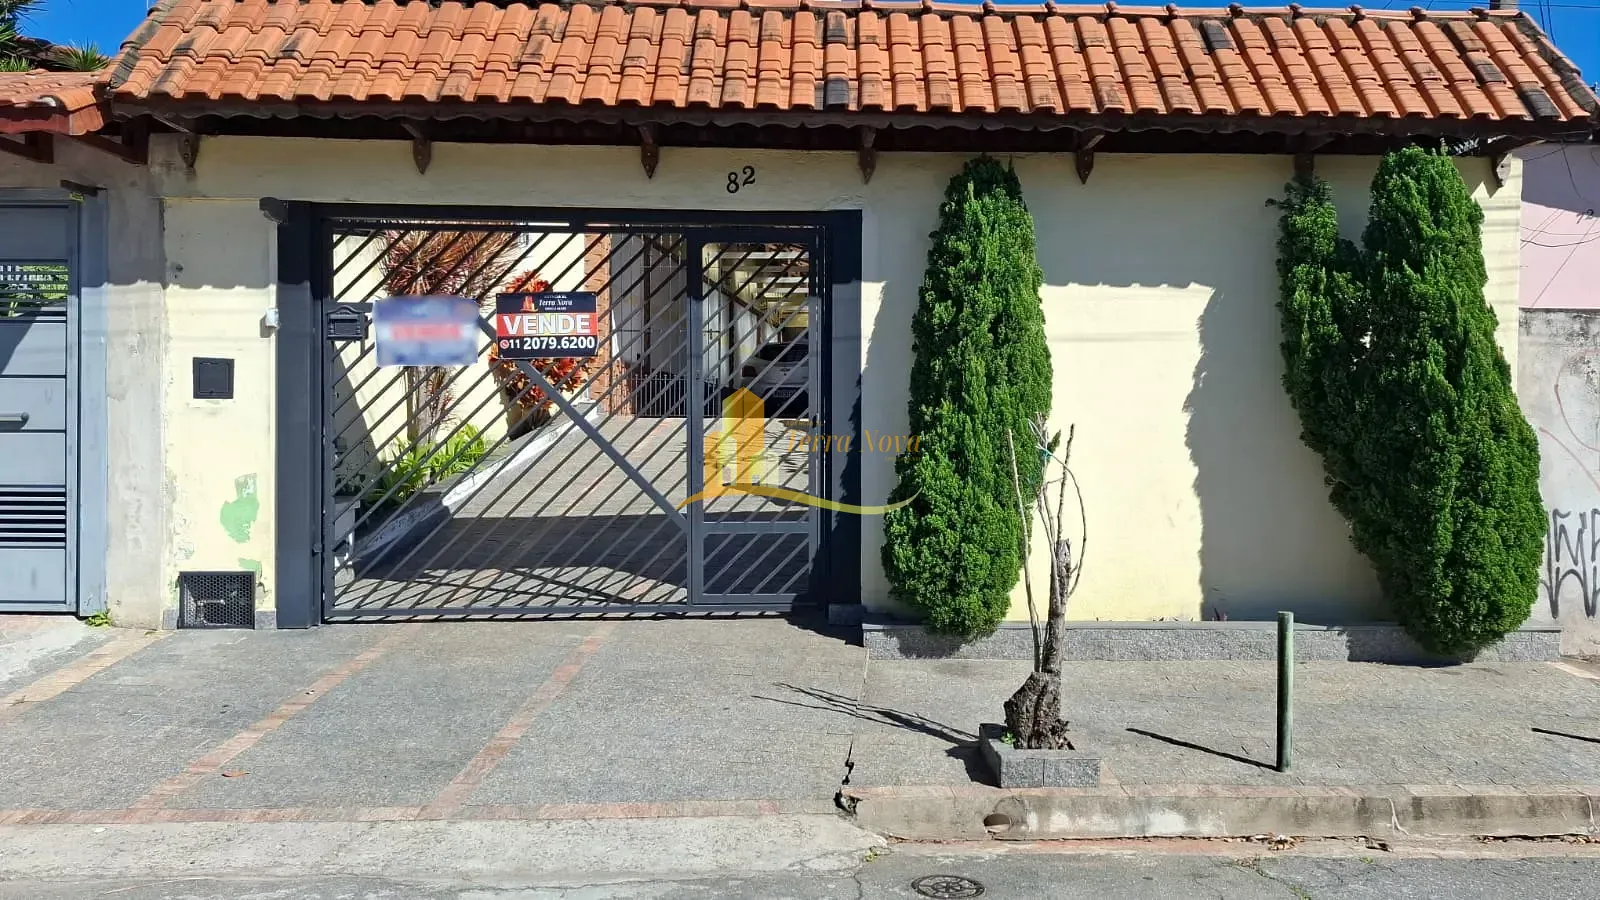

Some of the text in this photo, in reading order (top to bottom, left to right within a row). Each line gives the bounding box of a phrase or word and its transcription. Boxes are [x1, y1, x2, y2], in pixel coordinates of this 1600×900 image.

[726, 165, 756, 194] 82
[502, 314, 591, 335] VENDE
[509, 336, 595, 350] 11 2079.6200
